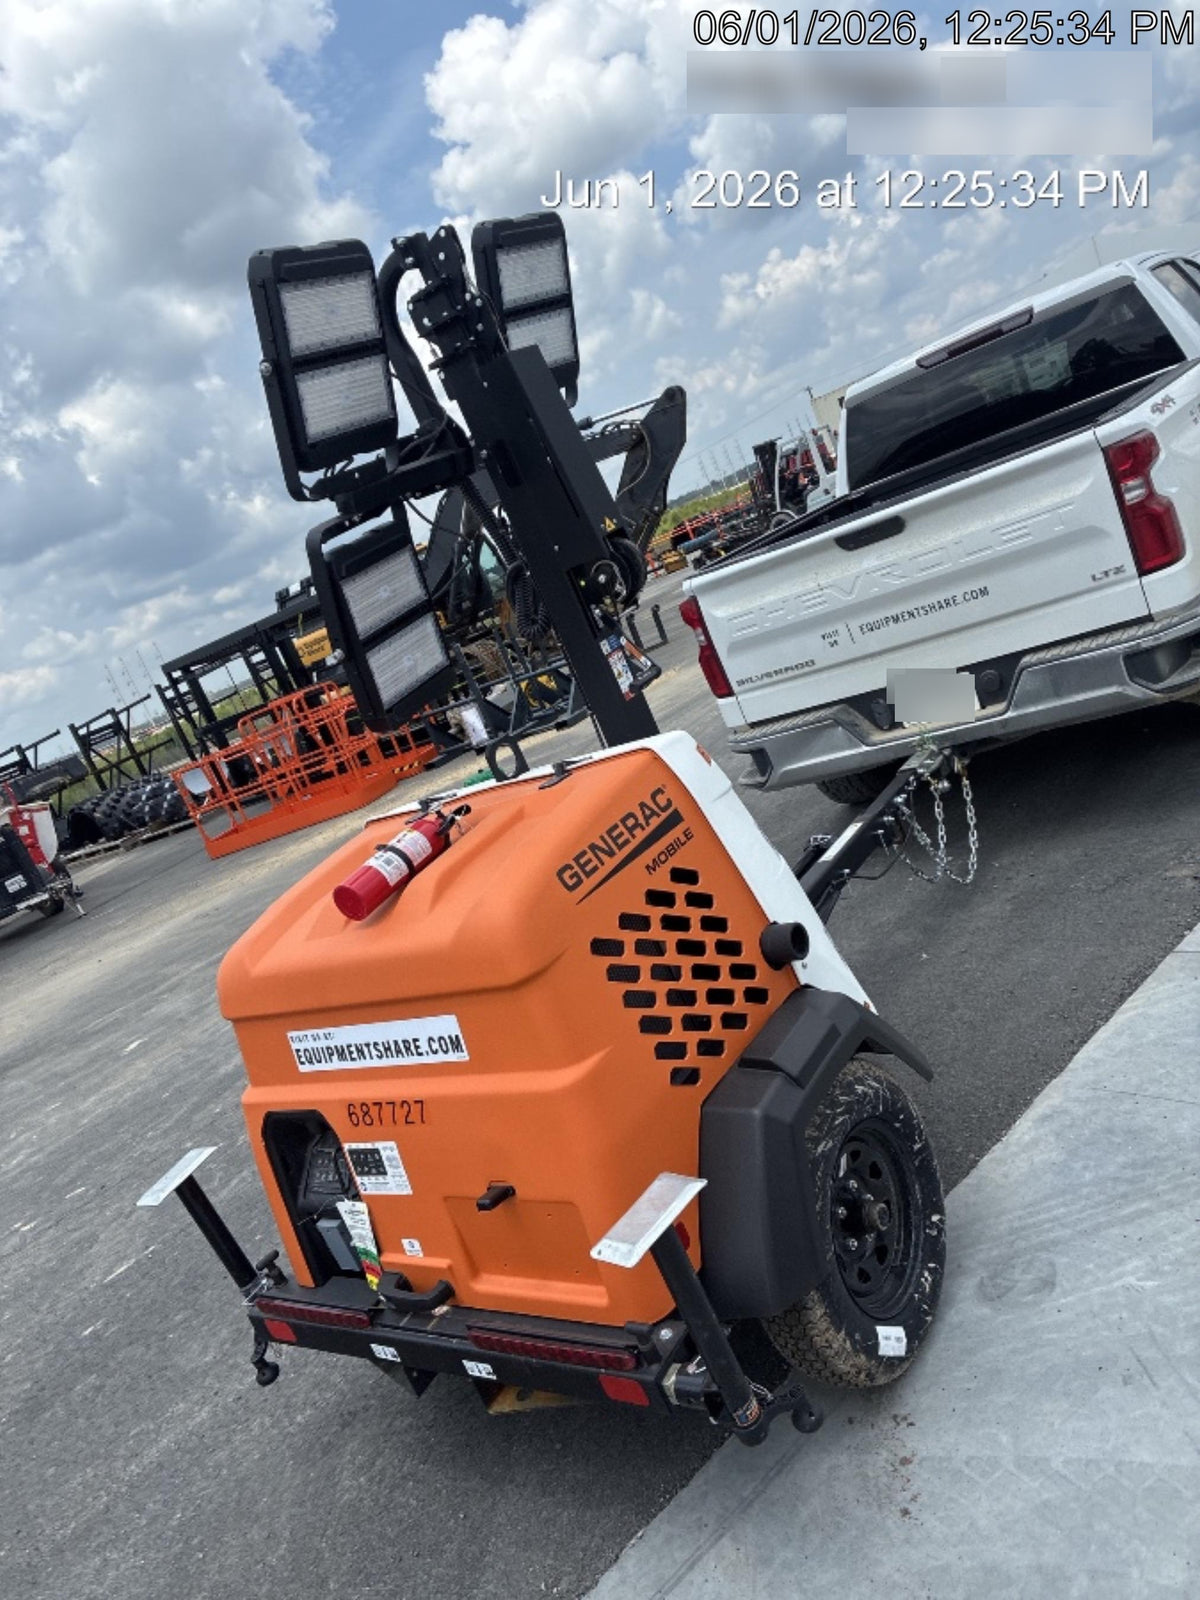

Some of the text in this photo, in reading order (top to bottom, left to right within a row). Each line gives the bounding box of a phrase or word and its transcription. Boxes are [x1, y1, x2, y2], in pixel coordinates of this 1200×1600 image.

[858, 586, 991, 636] EQUIPMENTSHARE.COM
[555, 786, 674, 893] GENERAC
[644, 826, 695, 876] MOBILE
[294, 1034, 465, 1066] EQUIPMENTSHARE.COM
[347, 1099, 427, 1128] 687727
